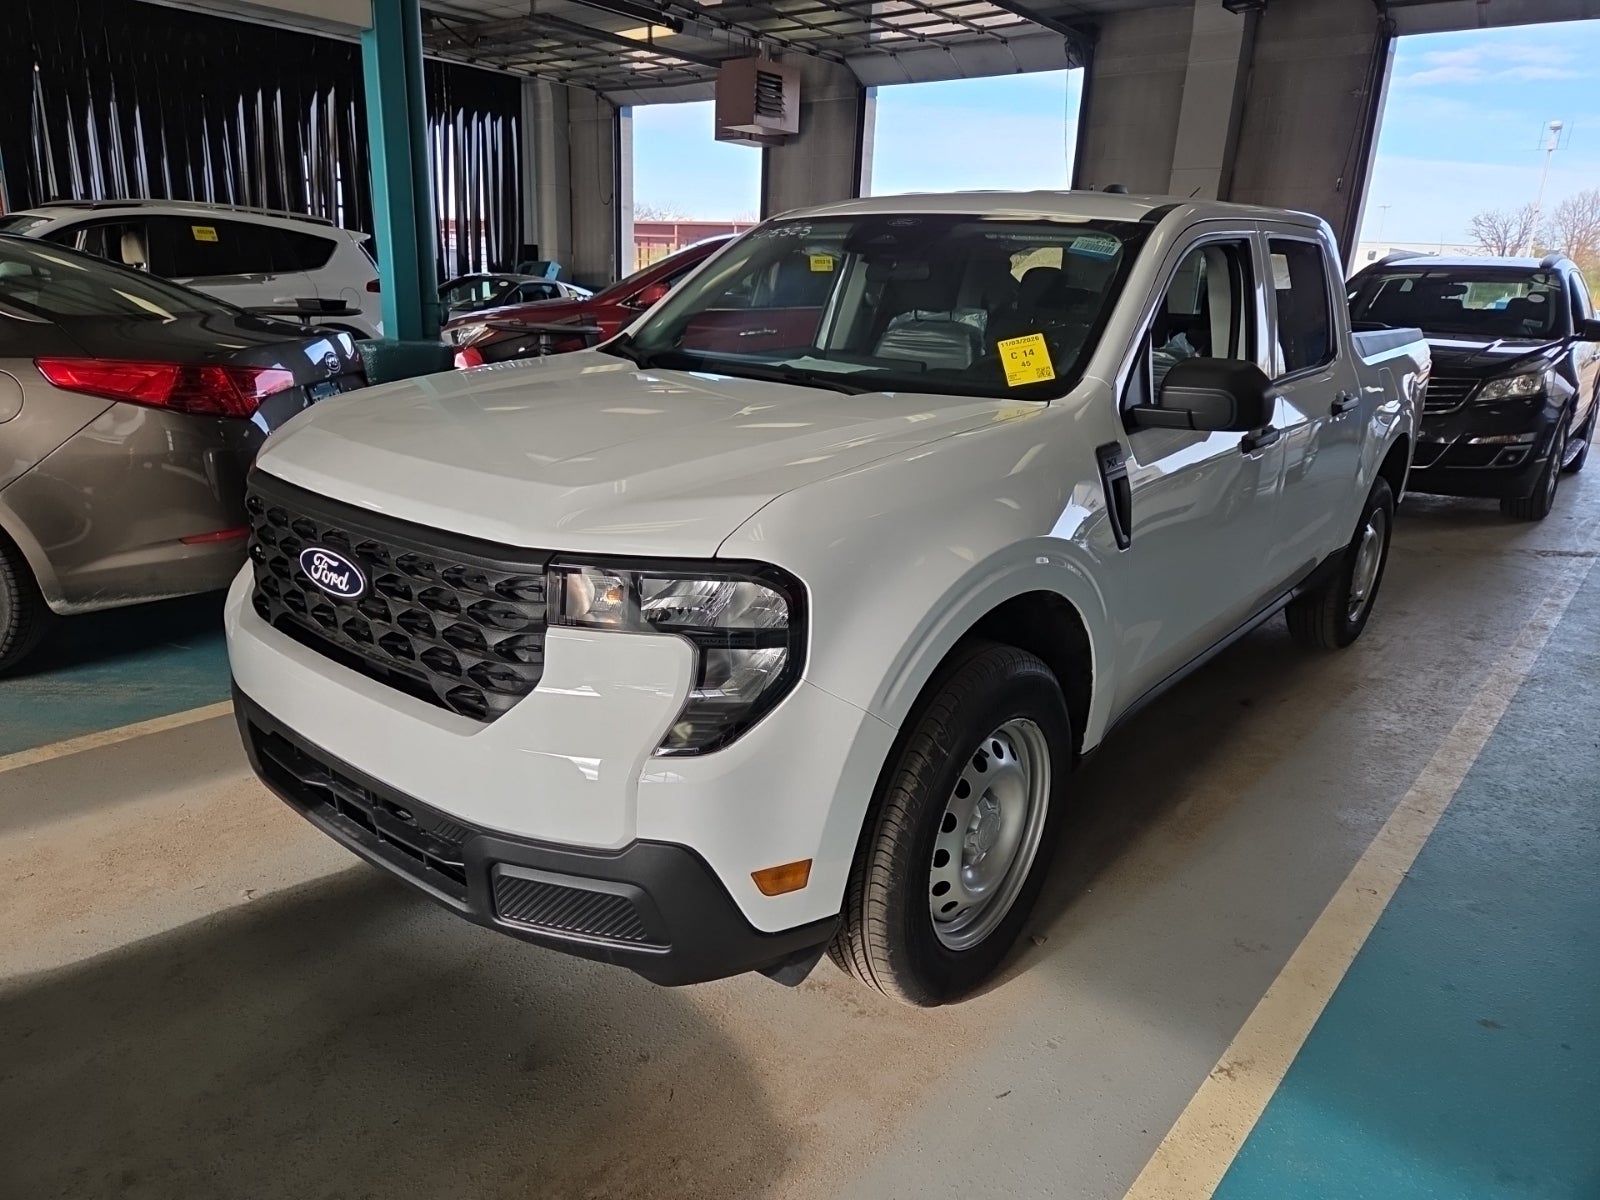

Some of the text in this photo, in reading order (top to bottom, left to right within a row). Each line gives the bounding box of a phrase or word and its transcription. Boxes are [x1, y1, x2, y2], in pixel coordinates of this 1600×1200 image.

[1000, 335, 1040, 348] 11/03/2026
[1010, 348, 1035, 360] C 14
[1021, 360, 1031, 368] 45
[311, 553, 350, 592] Ford
